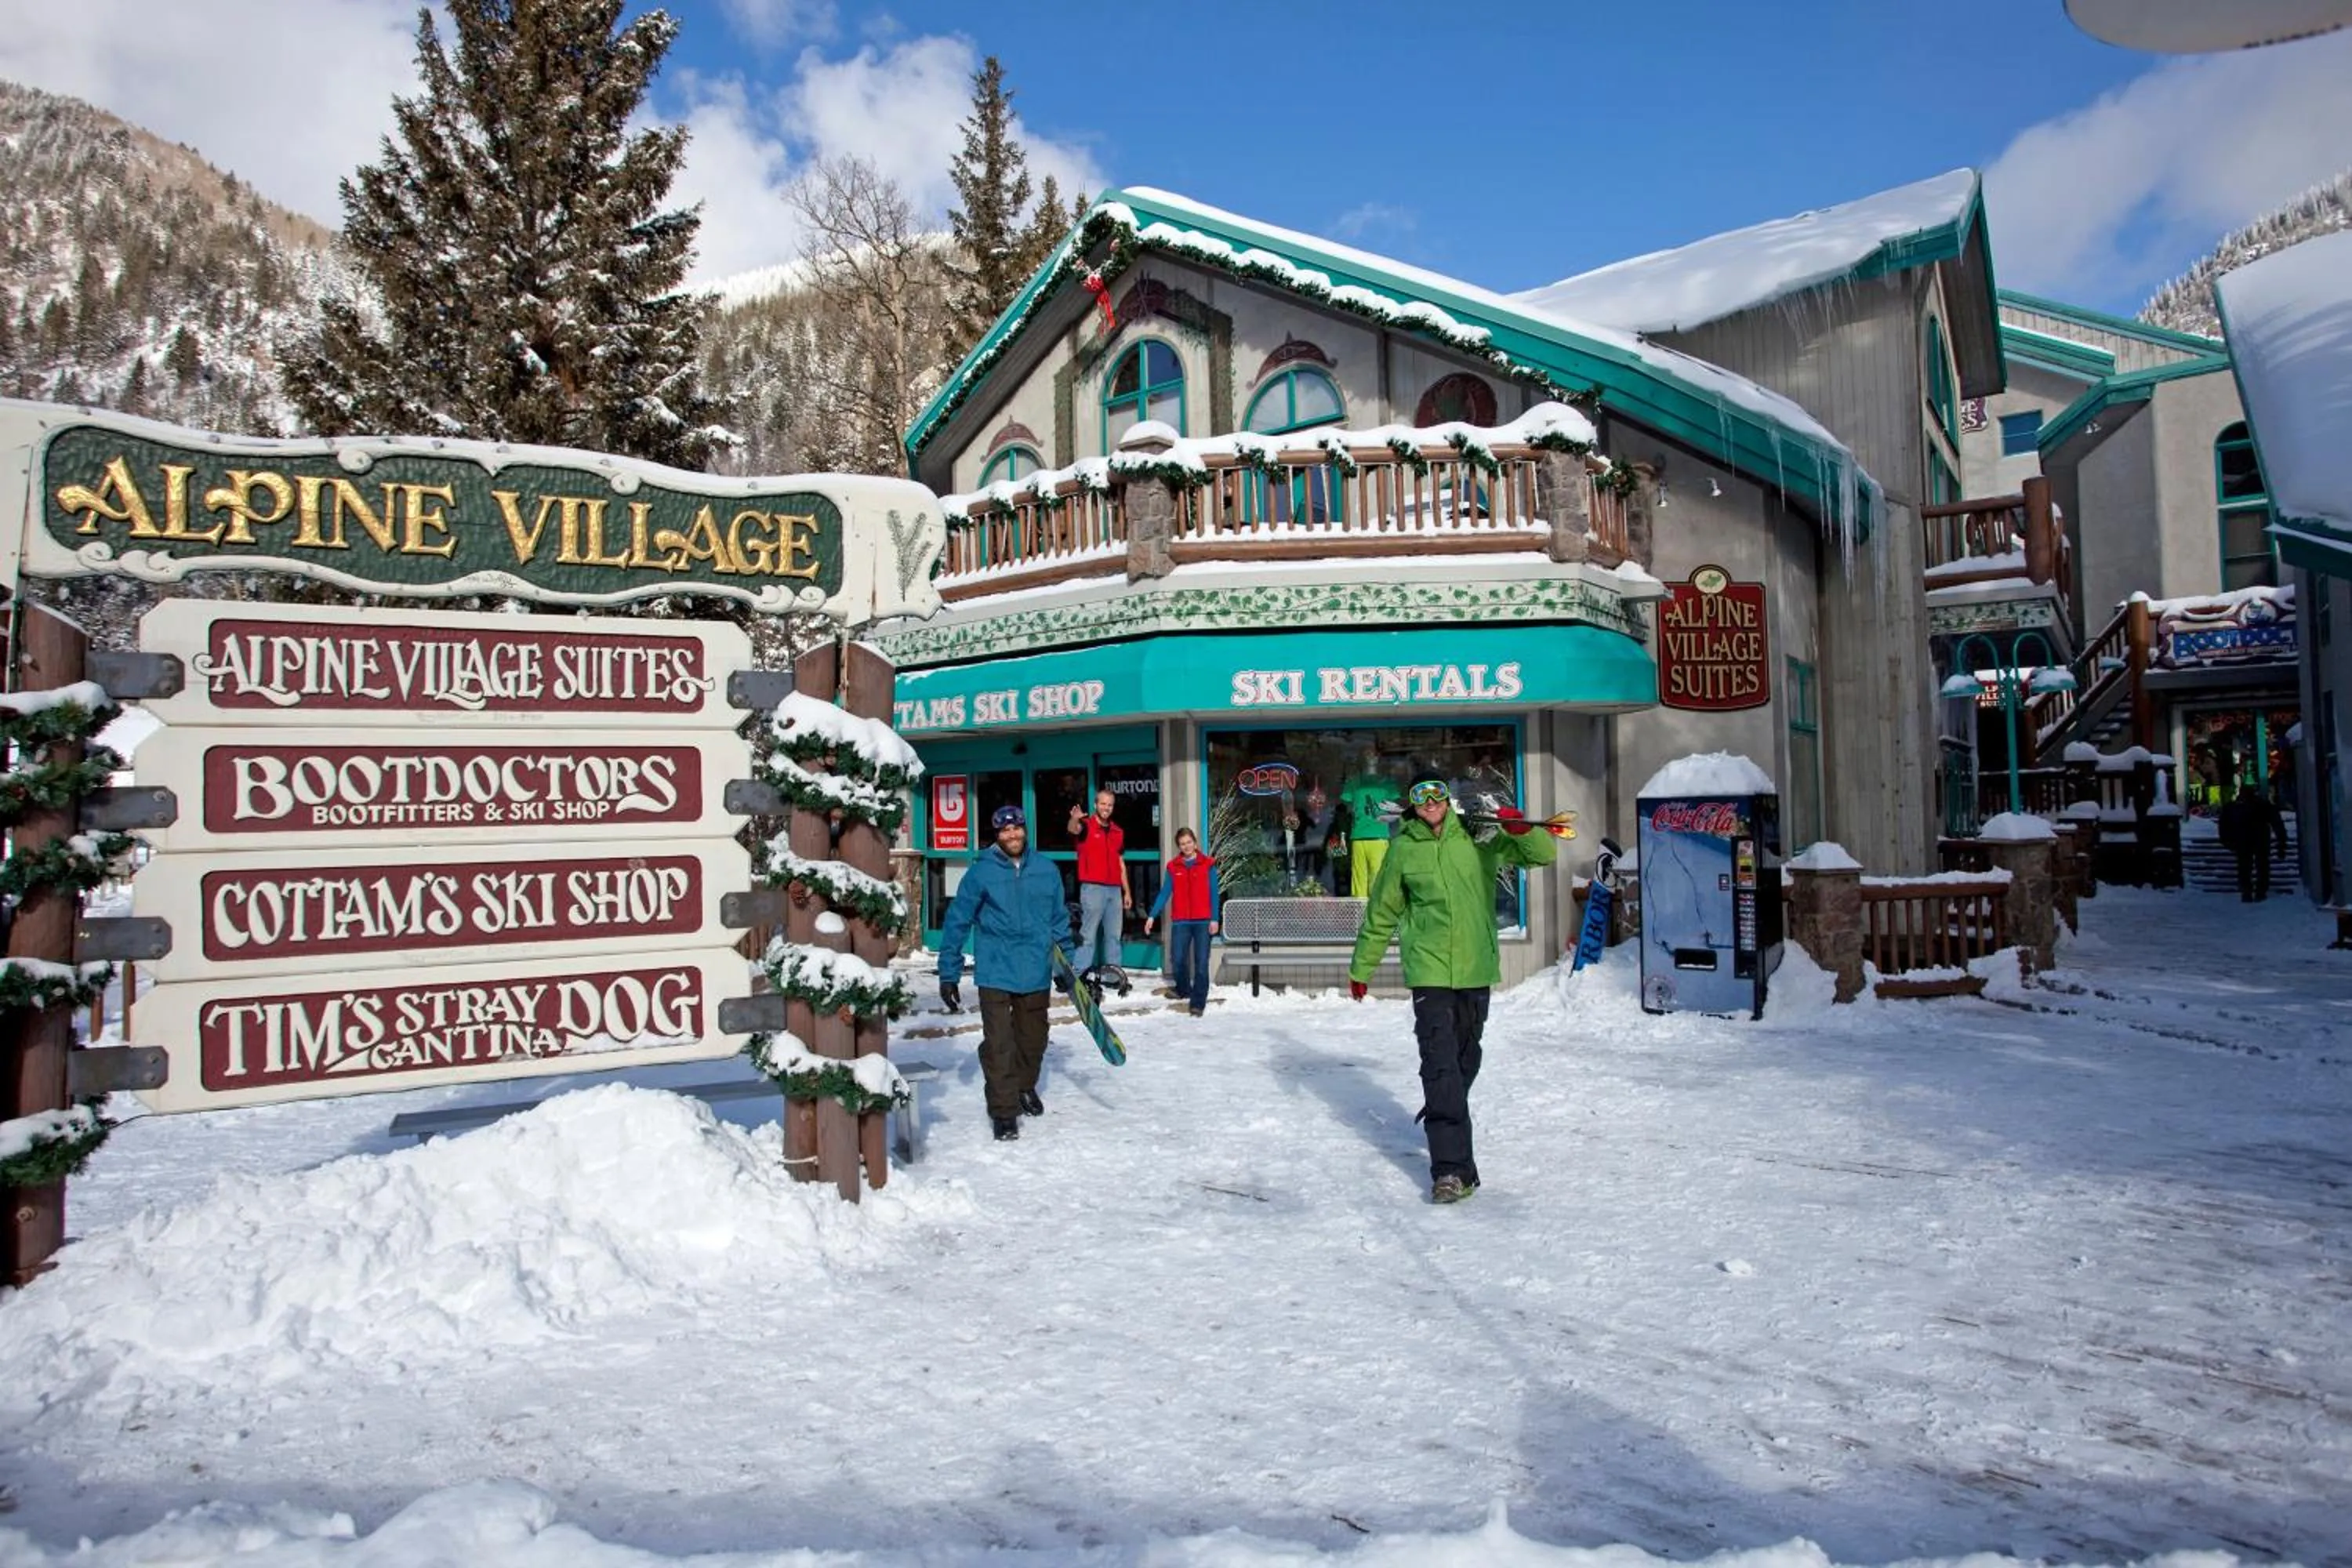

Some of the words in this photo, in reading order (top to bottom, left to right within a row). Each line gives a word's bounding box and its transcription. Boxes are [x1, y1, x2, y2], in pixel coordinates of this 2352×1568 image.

[56, 456, 459, 557] ALPINE
[491, 490, 821, 581] VILLAGE
[1664, 593, 1758, 627] ALPINE
[1665, 633, 1763, 661] VILLAGE
[193, 633, 390, 706] ALPINE
[387, 638, 544, 710] VILLAGE
[553, 645, 715, 703] SUITES
[1231, 670, 1305, 706] SKI
[1318, 662, 1523, 705] RENTALS
[1671, 665, 1759, 699] SUITES
[972, 689, 1019, 725] SKI
[1027, 680, 1104, 719] SHOP
[232, 755, 677, 820] BOOTDOCTORS
[1238, 768, 1299, 791] OPEN
[313, 804, 474, 824] BOOTFITTERS
[484, 802, 504, 821] &
[510, 801, 544, 820] SKI
[552, 800, 610, 819] SHOP
[213, 872, 463, 948] COTTAM'S
[471, 870, 557, 933] SKI
[567, 867, 689, 926] SHOP
[205, 993, 384, 1076] TIM'S
[395, 984, 547, 1036] STRAY
[556, 973, 699, 1042] DOG
[371, 1022, 561, 1069] CANTINA
